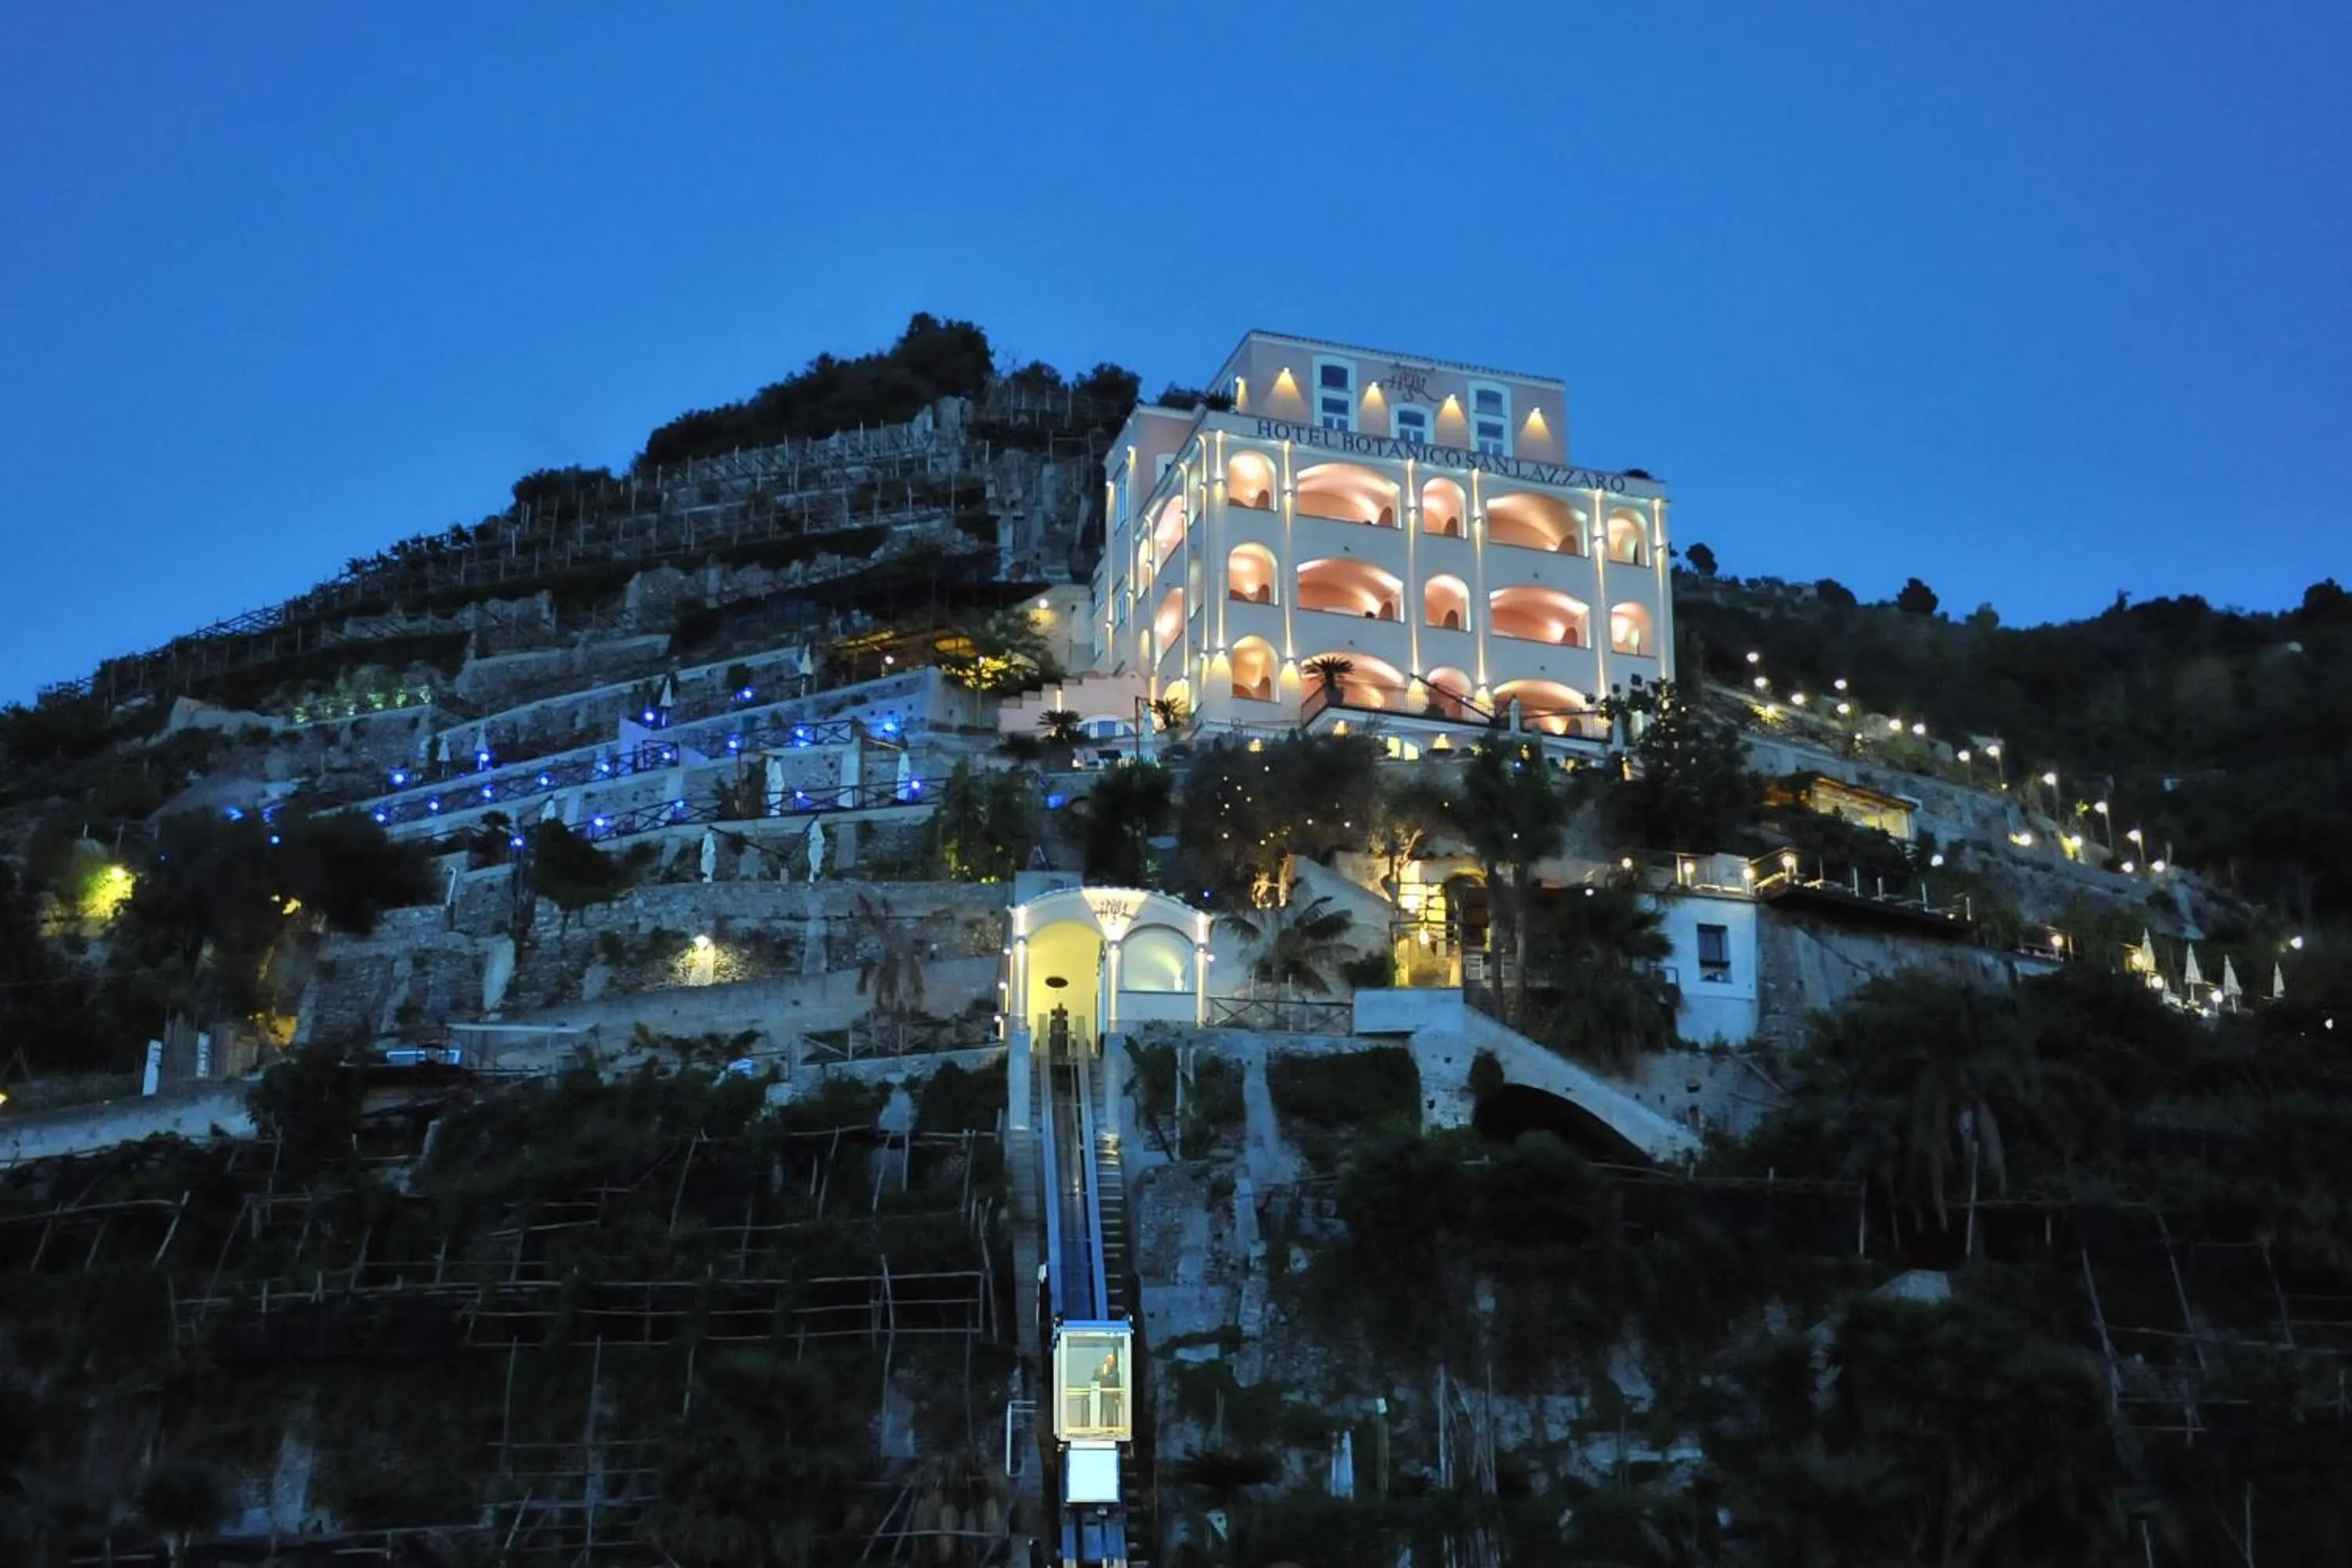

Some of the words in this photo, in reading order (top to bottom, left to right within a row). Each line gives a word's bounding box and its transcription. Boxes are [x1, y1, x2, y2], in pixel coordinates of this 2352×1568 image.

[1257, 419, 1337, 448] HOTEL
[1342, 434, 1461, 466] BOTANICO
[1465, 452, 1510, 477] SAN
[1510, 461, 1626, 493] LAZZARO
